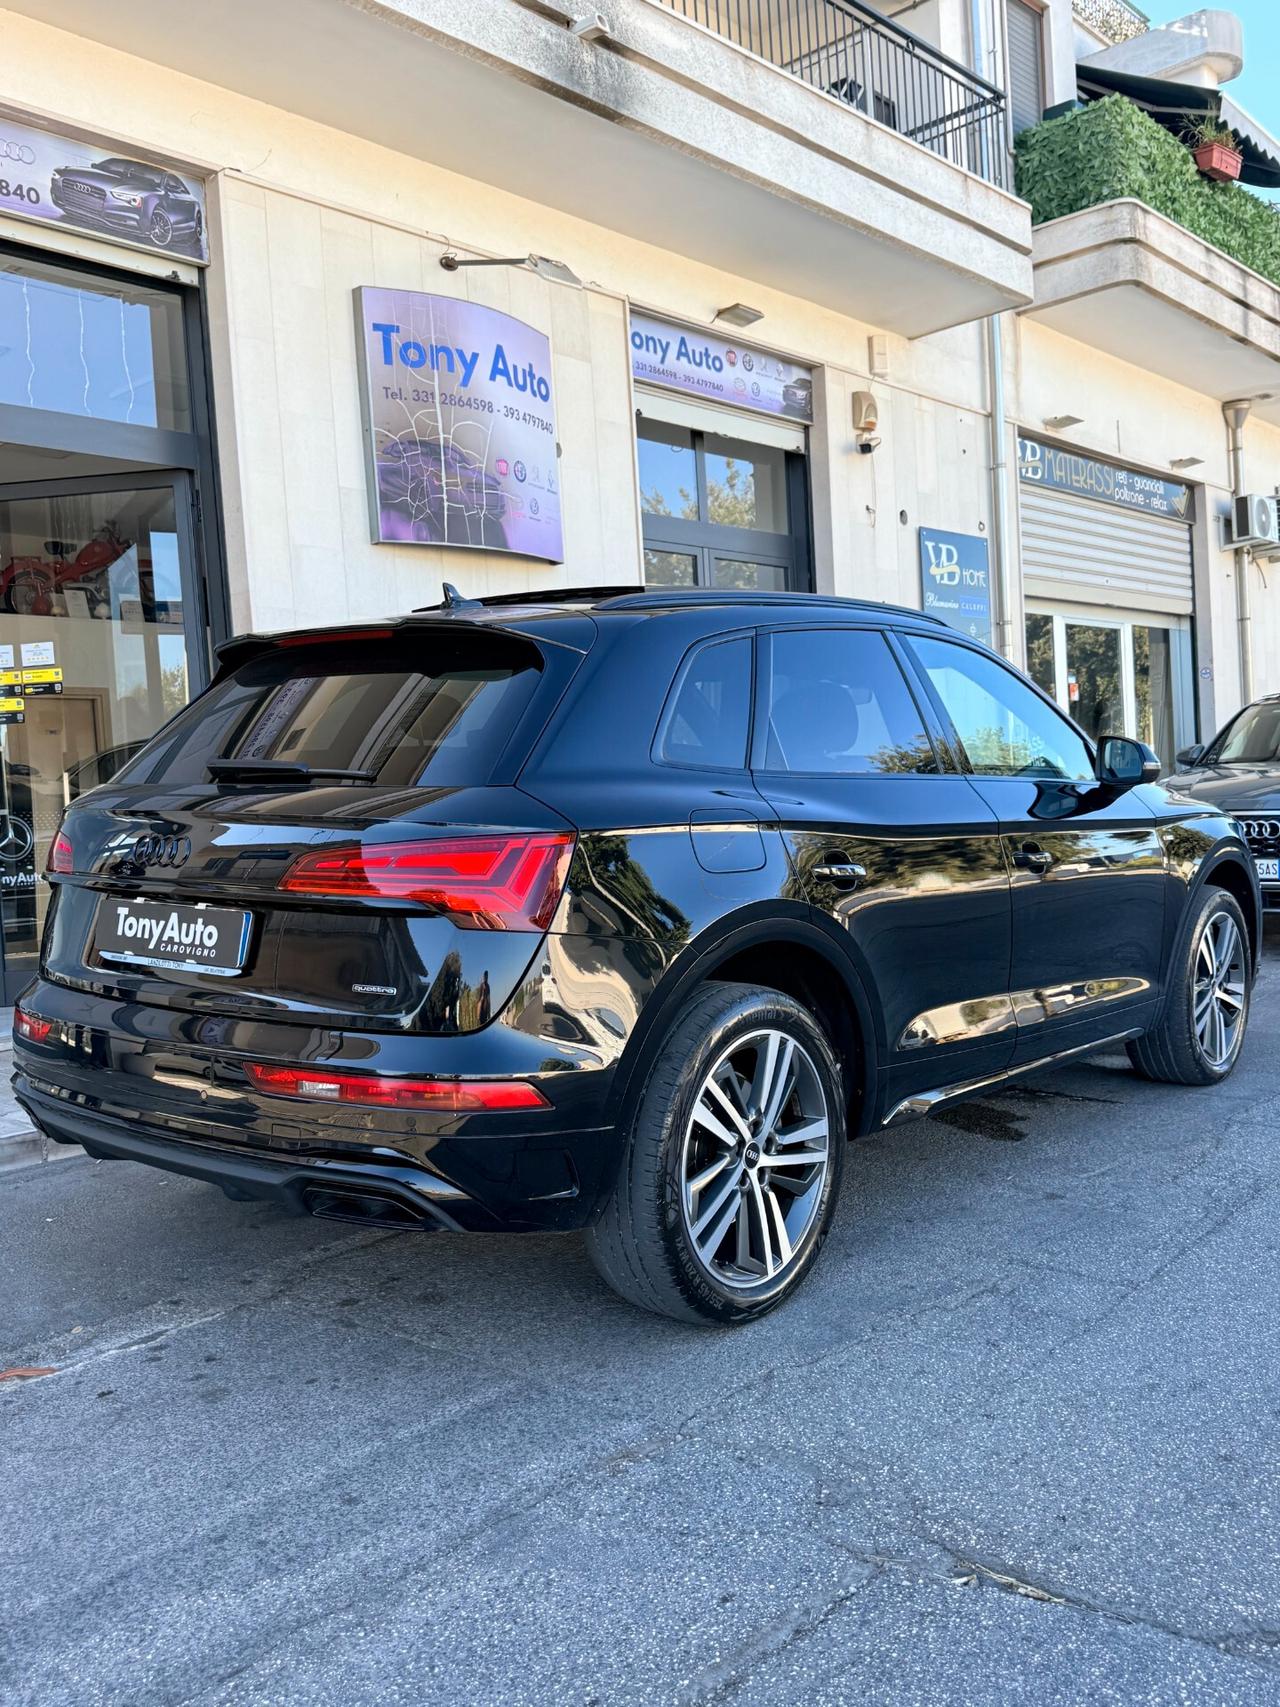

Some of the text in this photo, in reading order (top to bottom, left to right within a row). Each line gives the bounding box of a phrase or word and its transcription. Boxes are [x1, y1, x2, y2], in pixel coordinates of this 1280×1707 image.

[372, 322, 550, 402] Tony Auto
[630, 331, 723, 373] ony Auto
[383, 387, 407, 401] Tel.
[412, 389, 434, 404] 331
[441, 393, 494, 414] 2864598
[503, 406, 520, 421] 393
[522, 416, 554, 434] 4797840
[1044, 447, 1114, 497] MATERASSI
[1114, 486, 1145, 505] poltrone
[1151, 495, 1168, 511] relax
[962, 568, 987, 588] HOME
[1254, 863, 1278, 875] 5AS
[117, 907, 218, 949] TonyAuto
[160, 943, 217, 958] CAROVIGNO
[354, 985, 394, 994] quattro
